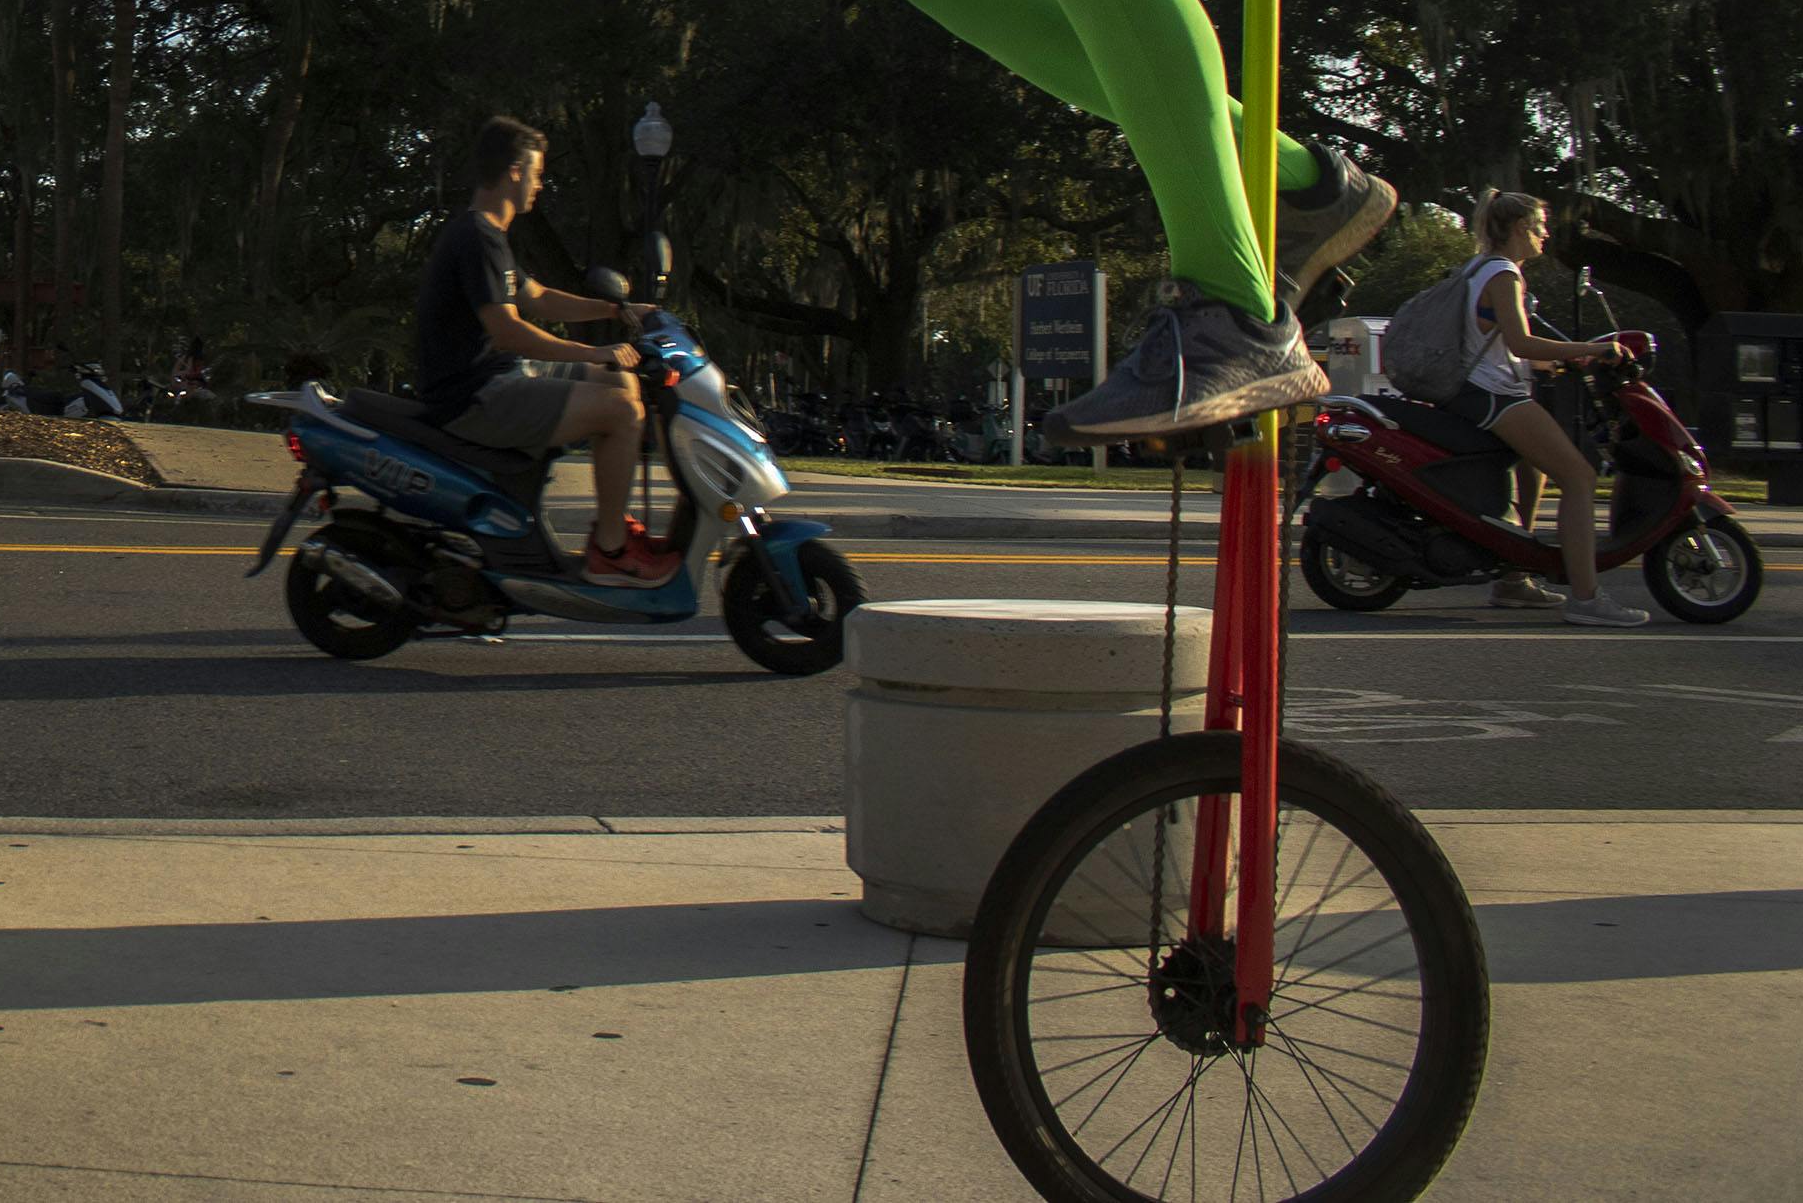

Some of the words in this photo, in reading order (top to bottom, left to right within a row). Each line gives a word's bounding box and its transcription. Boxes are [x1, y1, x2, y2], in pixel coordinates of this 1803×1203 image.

[1027, 273, 1044, 297] UF
[1046, 280, 1089, 296] FLORIDA
[364, 448, 436, 495] VIP
